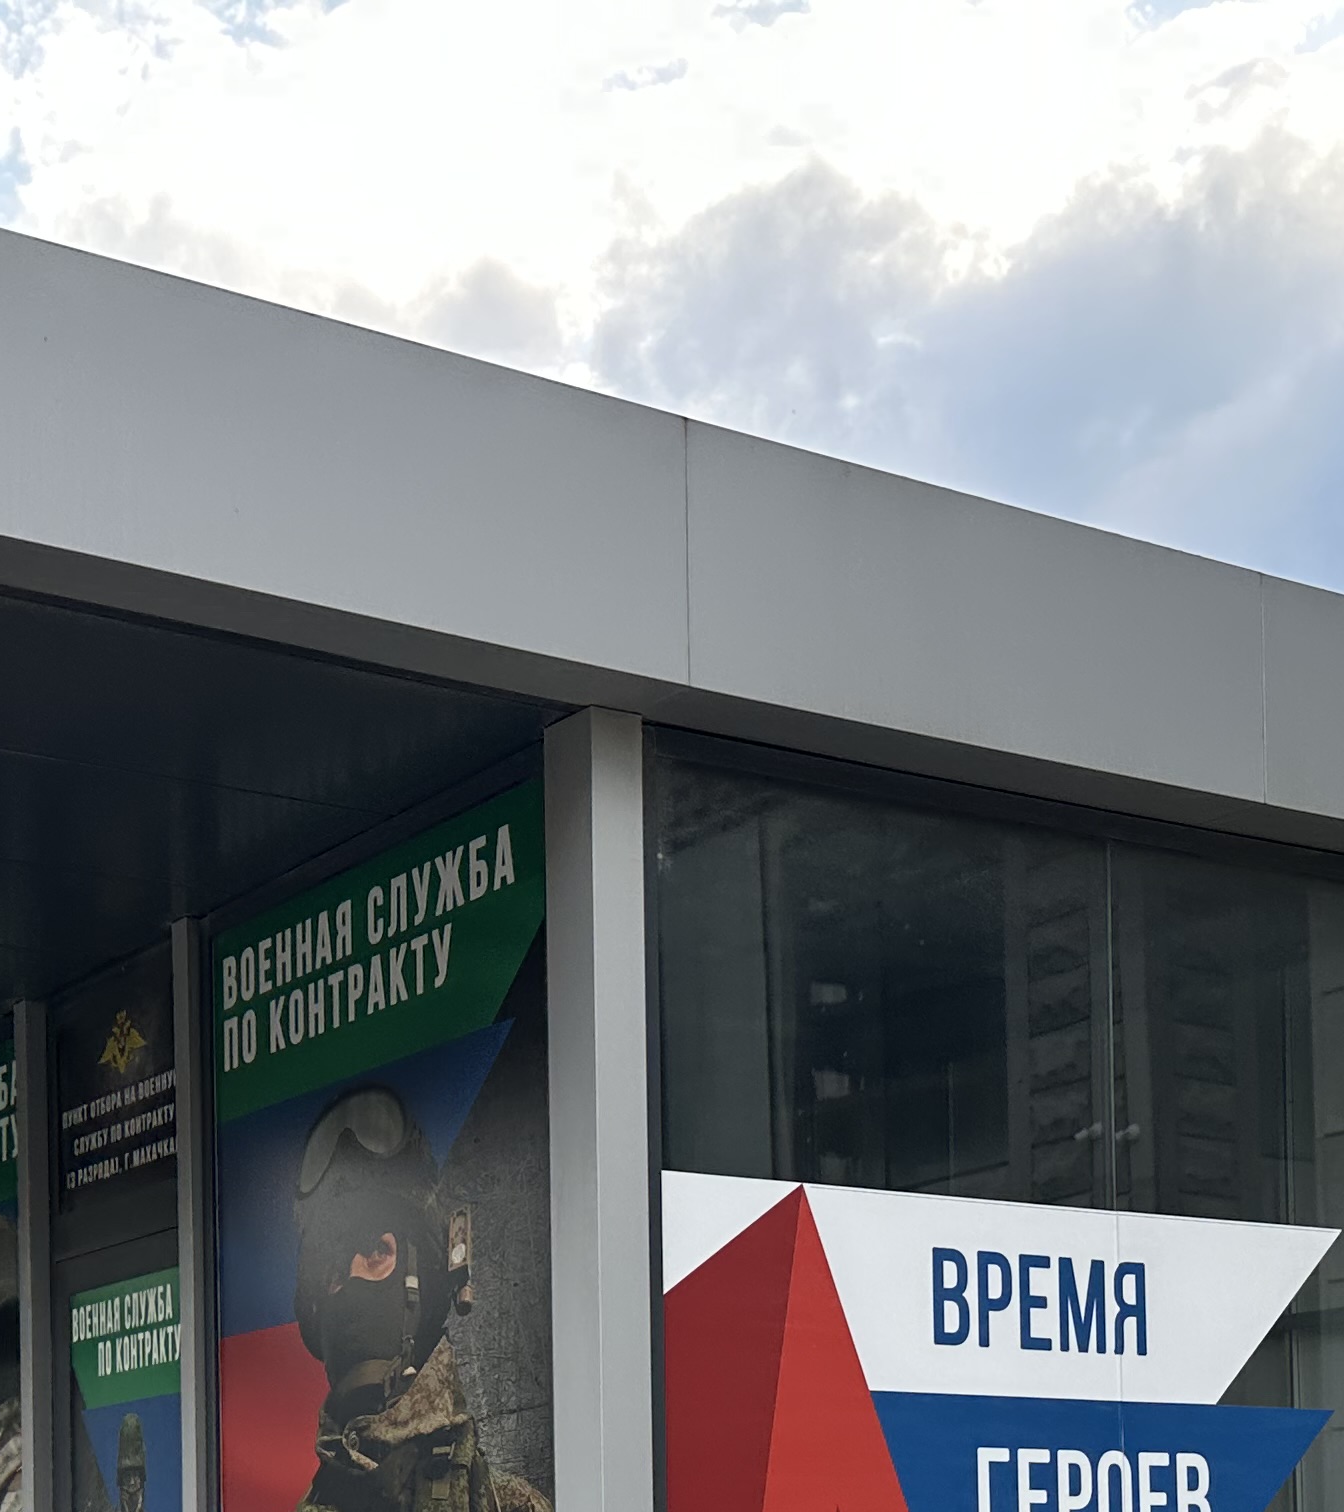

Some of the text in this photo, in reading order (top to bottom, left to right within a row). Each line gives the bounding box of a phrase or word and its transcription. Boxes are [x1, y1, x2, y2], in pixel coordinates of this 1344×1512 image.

[222, 823, 515, 1011] ВОЕННАЯ СЛУЖБА
[223, 922, 452, 1073] ПО КОНТРАКТУ
[62, 1104, 89, 1130] ПУНКТ
[90, 1091, 123, 1119] ОТБОРА
[124, 1085, 136, 1106] НА
[73, 1103, 175, 1157] СЛУЖБУ ПО КОНТРАКТУ
[124, 1136, 177, 1170] Г.МАХАЧКА
[72, 1283, 173, 1342] ВОЕННАЯ СЛУЖБА
[932, 1246, 1148, 1357] ВРЕМЯ
[97, 1323, 181, 1377] ПО КОНТРАКТУ
